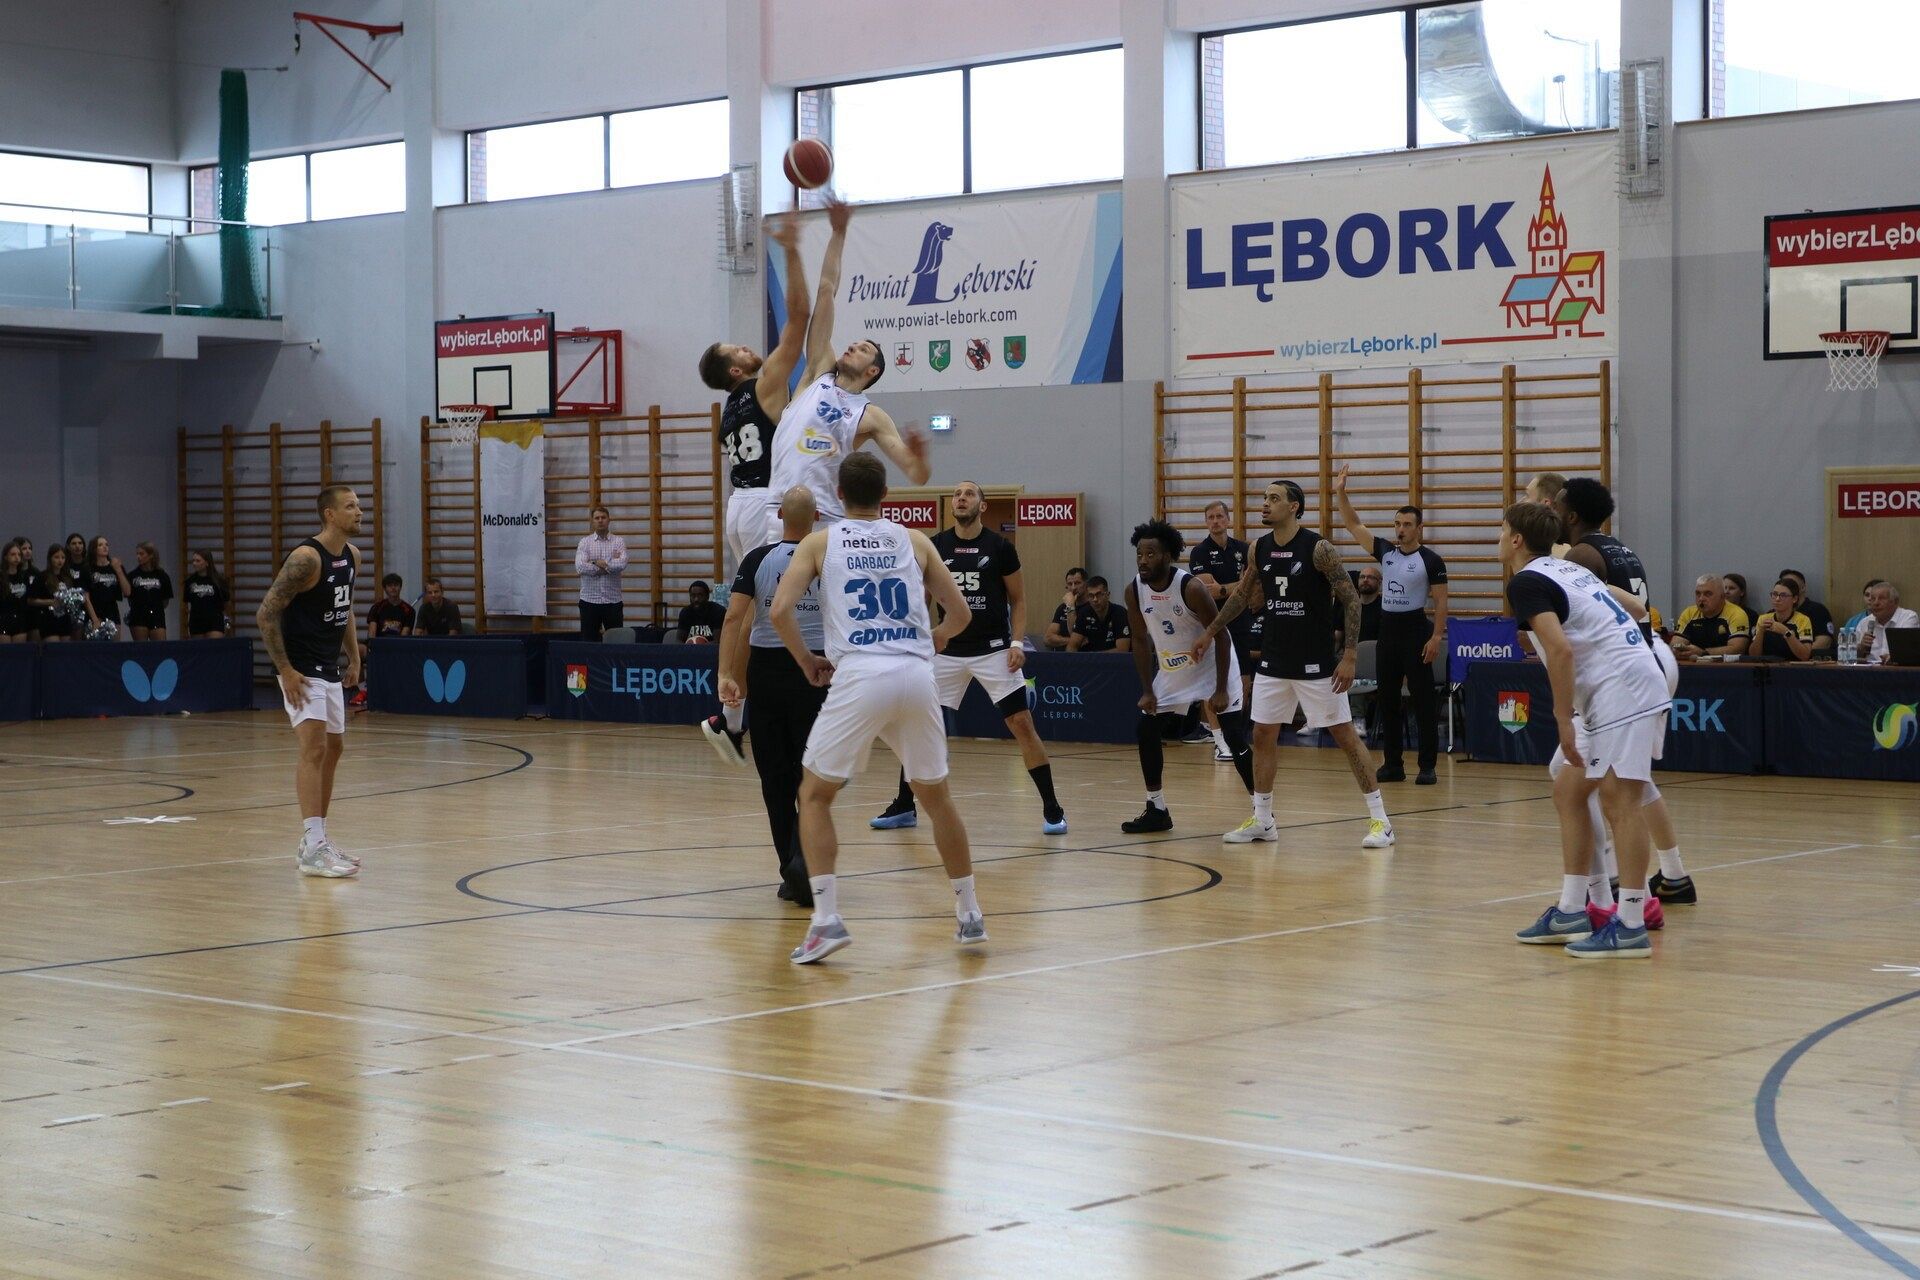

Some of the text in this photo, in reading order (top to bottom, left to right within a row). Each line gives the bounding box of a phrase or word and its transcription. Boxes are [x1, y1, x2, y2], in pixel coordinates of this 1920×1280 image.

[1186, 201, 1516, 303] LĘBORK
[848, 222, 1038, 306] Powiat Lęborski
[864, 308, 1018, 331] www.powiat-lebork.com
[440, 324, 545, 352] wybierzLębork.pl
[1280, 332, 1437, 358] wybierzLębork.pl
[1020, 504, 1073, 524] LĘBORK
[842, 538, 880, 549] netia
[847, 556, 897, 570] GARBACZ
[950, 571, 980, 591] 25
[1275, 576, 1289, 597] 7
[333, 584, 351, 608] 21
[844, 577, 910, 621] 30
[1275, 600, 1304, 611] Energa
[795, 602, 820, 611] ekao
[848, 627, 917, 645] GDYNIA
[1162, 620, 1175, 635] 3
[1457, 642, 1513, 658] molten
[1166, 655, 1188, 667] LOTTO
[612, 667, 712, 699] LĘBORK
[1043, 685, 1083, 705] CSiR
[1043, 711, 1084, 719] LĘBORK
